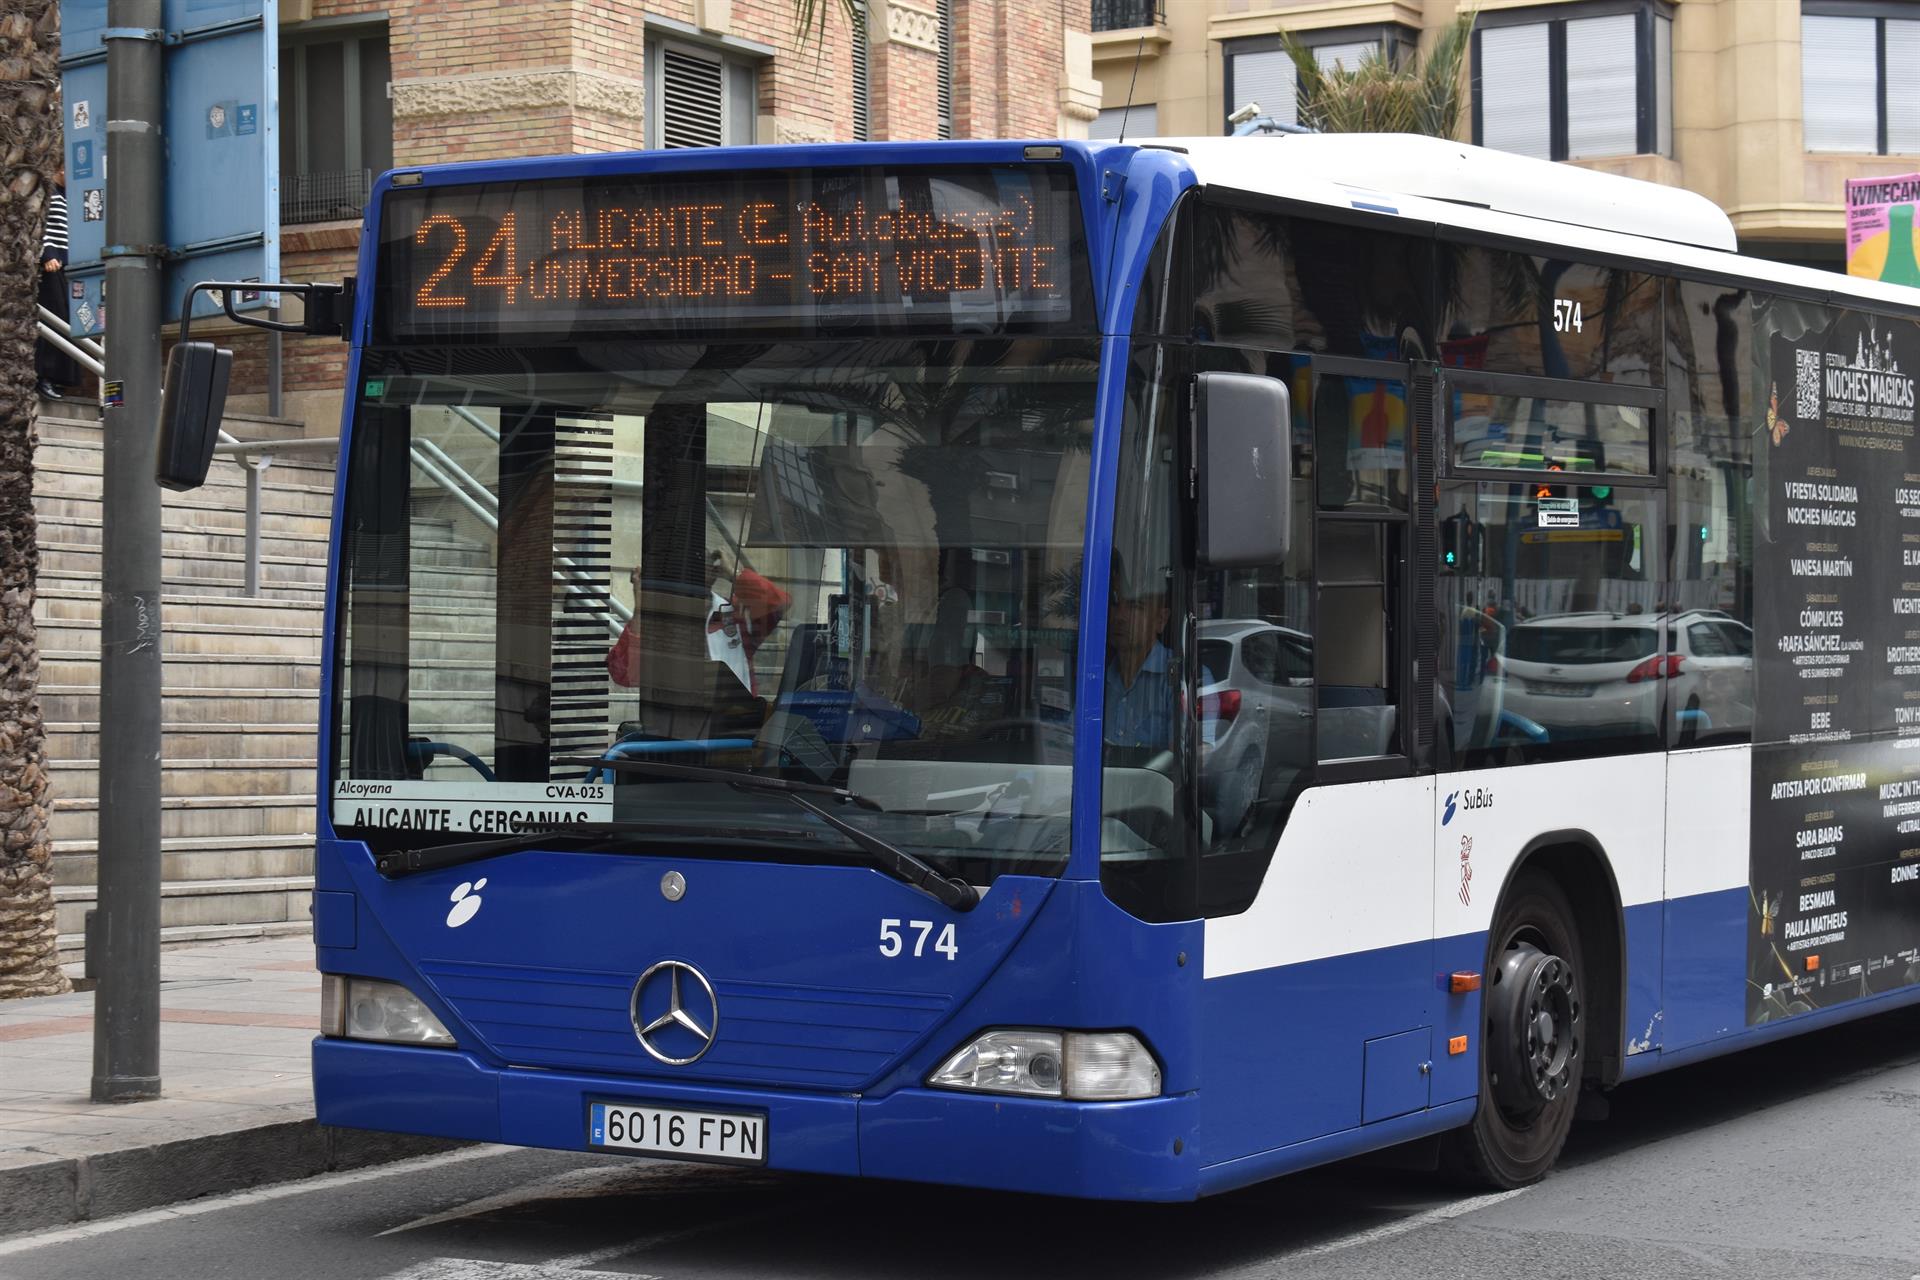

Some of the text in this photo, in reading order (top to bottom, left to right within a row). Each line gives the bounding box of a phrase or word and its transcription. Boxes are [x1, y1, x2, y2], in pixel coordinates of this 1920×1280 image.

[1852, 181, 1920, 206] WINECAN
[552, 193, 1035, 249] ALICANTE (E. Autobuses)
[416, 212, 521, 306] 24
[529, 254, 758, 299] UNIVERSIDAD
[807, 251, 882, 294] SAN
[899, 245, 1057, 293] VICENTE
[1554, 299, 1583, 333] 574
[1826, 369, 1914, 408] NOCHES MAGICAS
[1785, 482, 1858, 503] V FIESTA SOLIDARIA
[1895, 488, 1909, 505] LOS
[1787, 504, 1856, 527] NOCHES MÁGICAS
[1791, 555, 1853, 576] VANESA MARTÍN
[1903, 550, 1911, 566] EL
[1800, 606, 1844, 627] CÓMPLICES
[1804, 630, 1840, 652] SÁNCHEZ
[1811, 712, 1831, 729] BEBE
[1894, 706, 1914, 723] TONY
[338, 781, 604, 799] Alcoyana CVA-025
[1771, 773, 1866, 800] ARTISTA POR CONFIRMAR
[1879, 782, 1903, 800] MUSIC
[1903, 780, 1911, 798] IN
[1464, 787, 1493, 810] SuBús
[1883, 801, 1897, 818] IVÁN
[354, 808, 450, 831] ALICANTE
[1796, 825, 1843, 848] SARA BARAS
[1891, 864, 1918, 883] BONNIE
[1800, 890, 1835, 912] BESMAYA
[1785, 911, 1847, 939] PAULA MATHEUS
[879, 918, 958, 960] 574
[594, 1109, 757, 1154] E 6016 FPN
